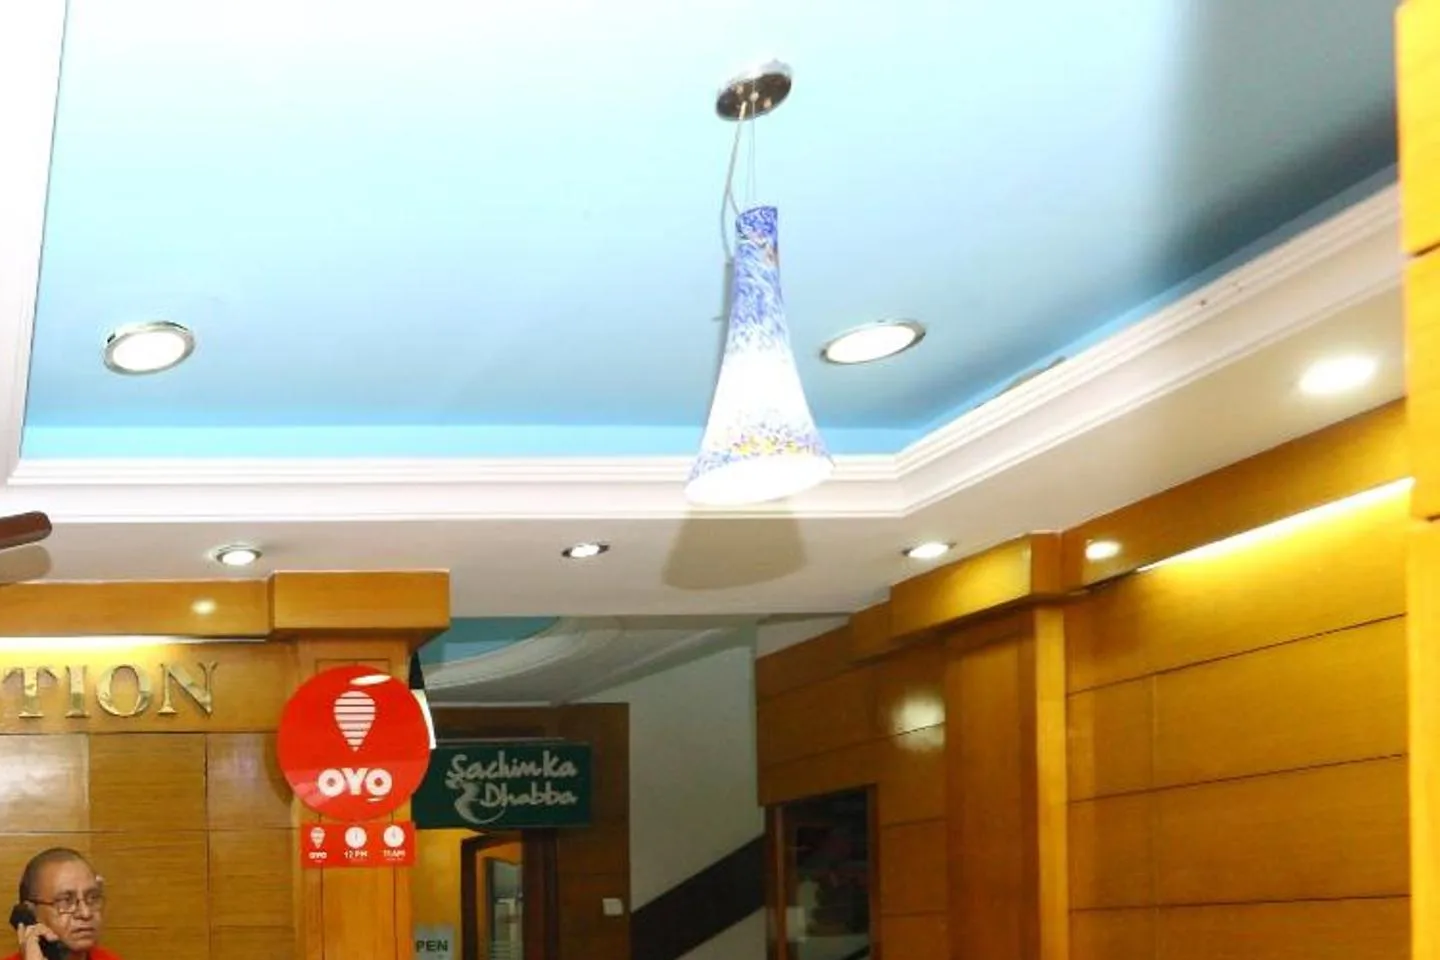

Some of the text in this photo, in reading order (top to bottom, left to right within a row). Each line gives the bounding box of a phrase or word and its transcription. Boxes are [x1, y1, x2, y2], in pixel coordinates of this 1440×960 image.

[317, 767, 393, 799] OYO
[480, 781, 578, 807] Dhabba
[415, 939, 449, 953] PEN
